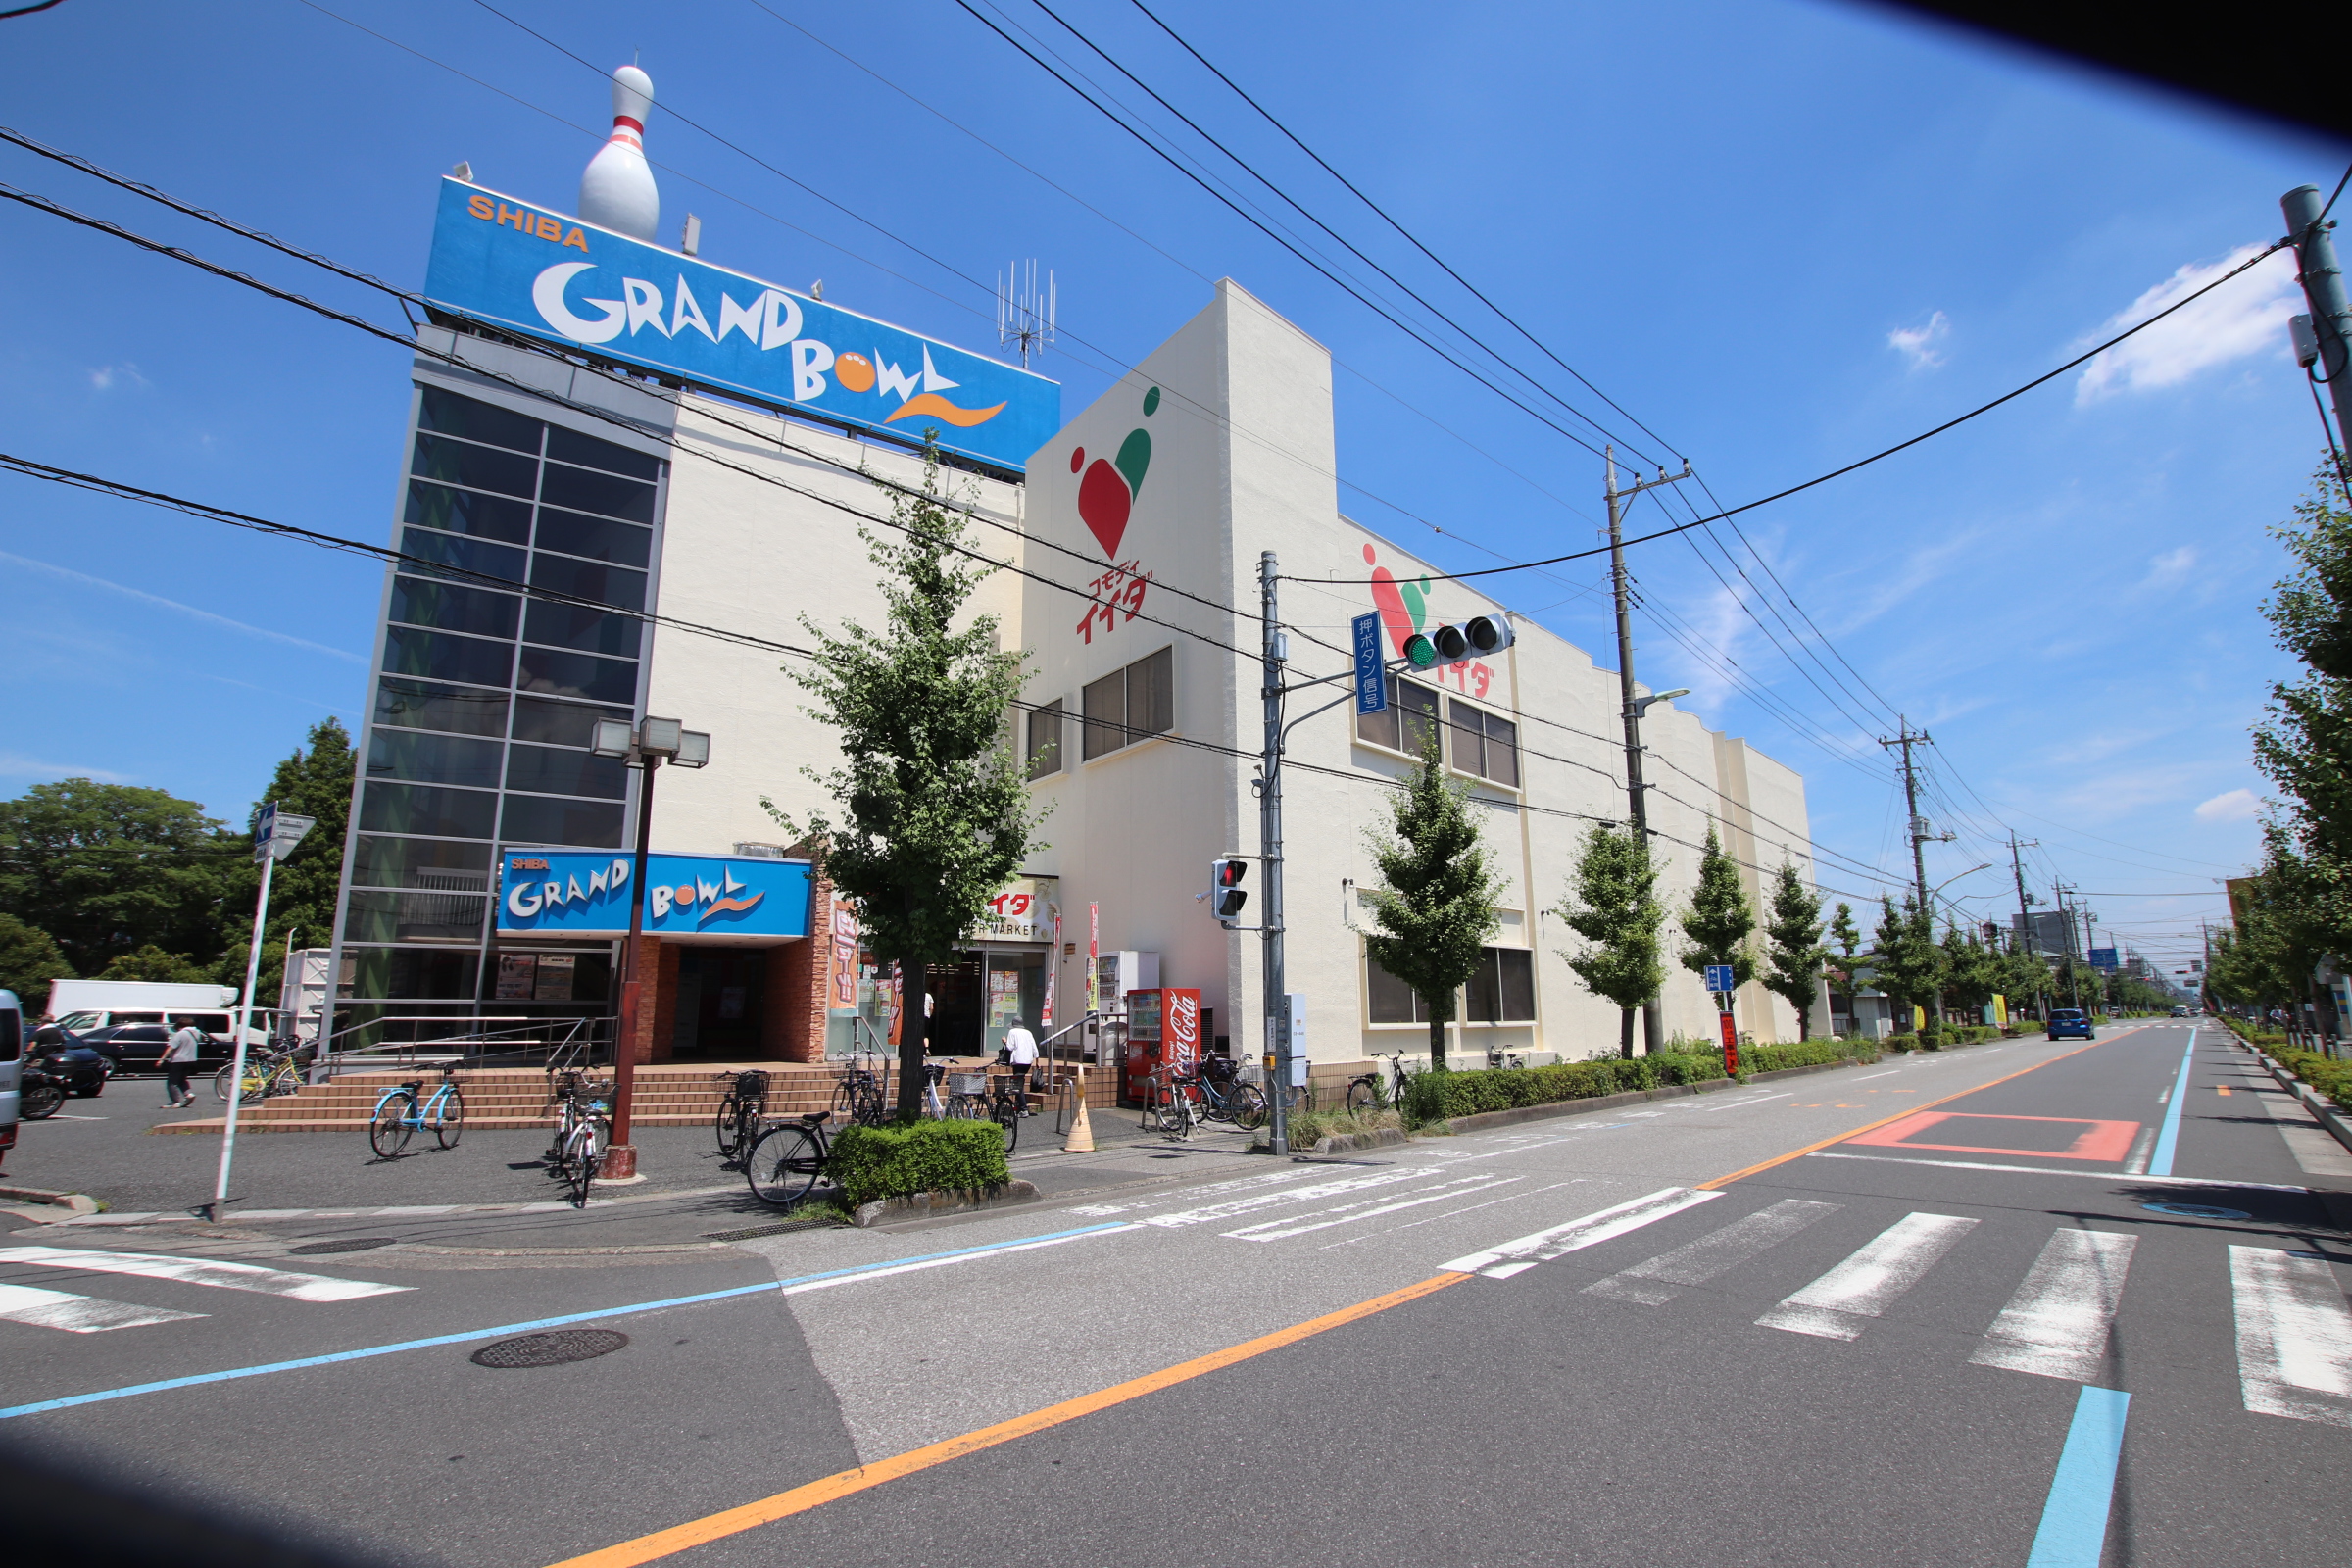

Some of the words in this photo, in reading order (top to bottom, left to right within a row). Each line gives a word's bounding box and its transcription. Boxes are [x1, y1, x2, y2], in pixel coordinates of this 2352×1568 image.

[467, 194, 589, 254] SHIBA
[532, 261, 803, 351] GRAND
[791, 338, 960, 403] BOWL
[1076, 569, 1153, 645] イイダ
[1089, 560, 1140, 601] コモディ
[1359, 618, 1379, 709] 押ボタン信号
[508, 858, 630, 917] GRAND
[651, 862, 747, 919] BOWL
[511, 858, 550, 870] SHIBA
[987, 893, 1035, 916] イダ
[990, 924, 1037, 936] MARKET
[1170, 990, 1198, 1078] oca-Cola
